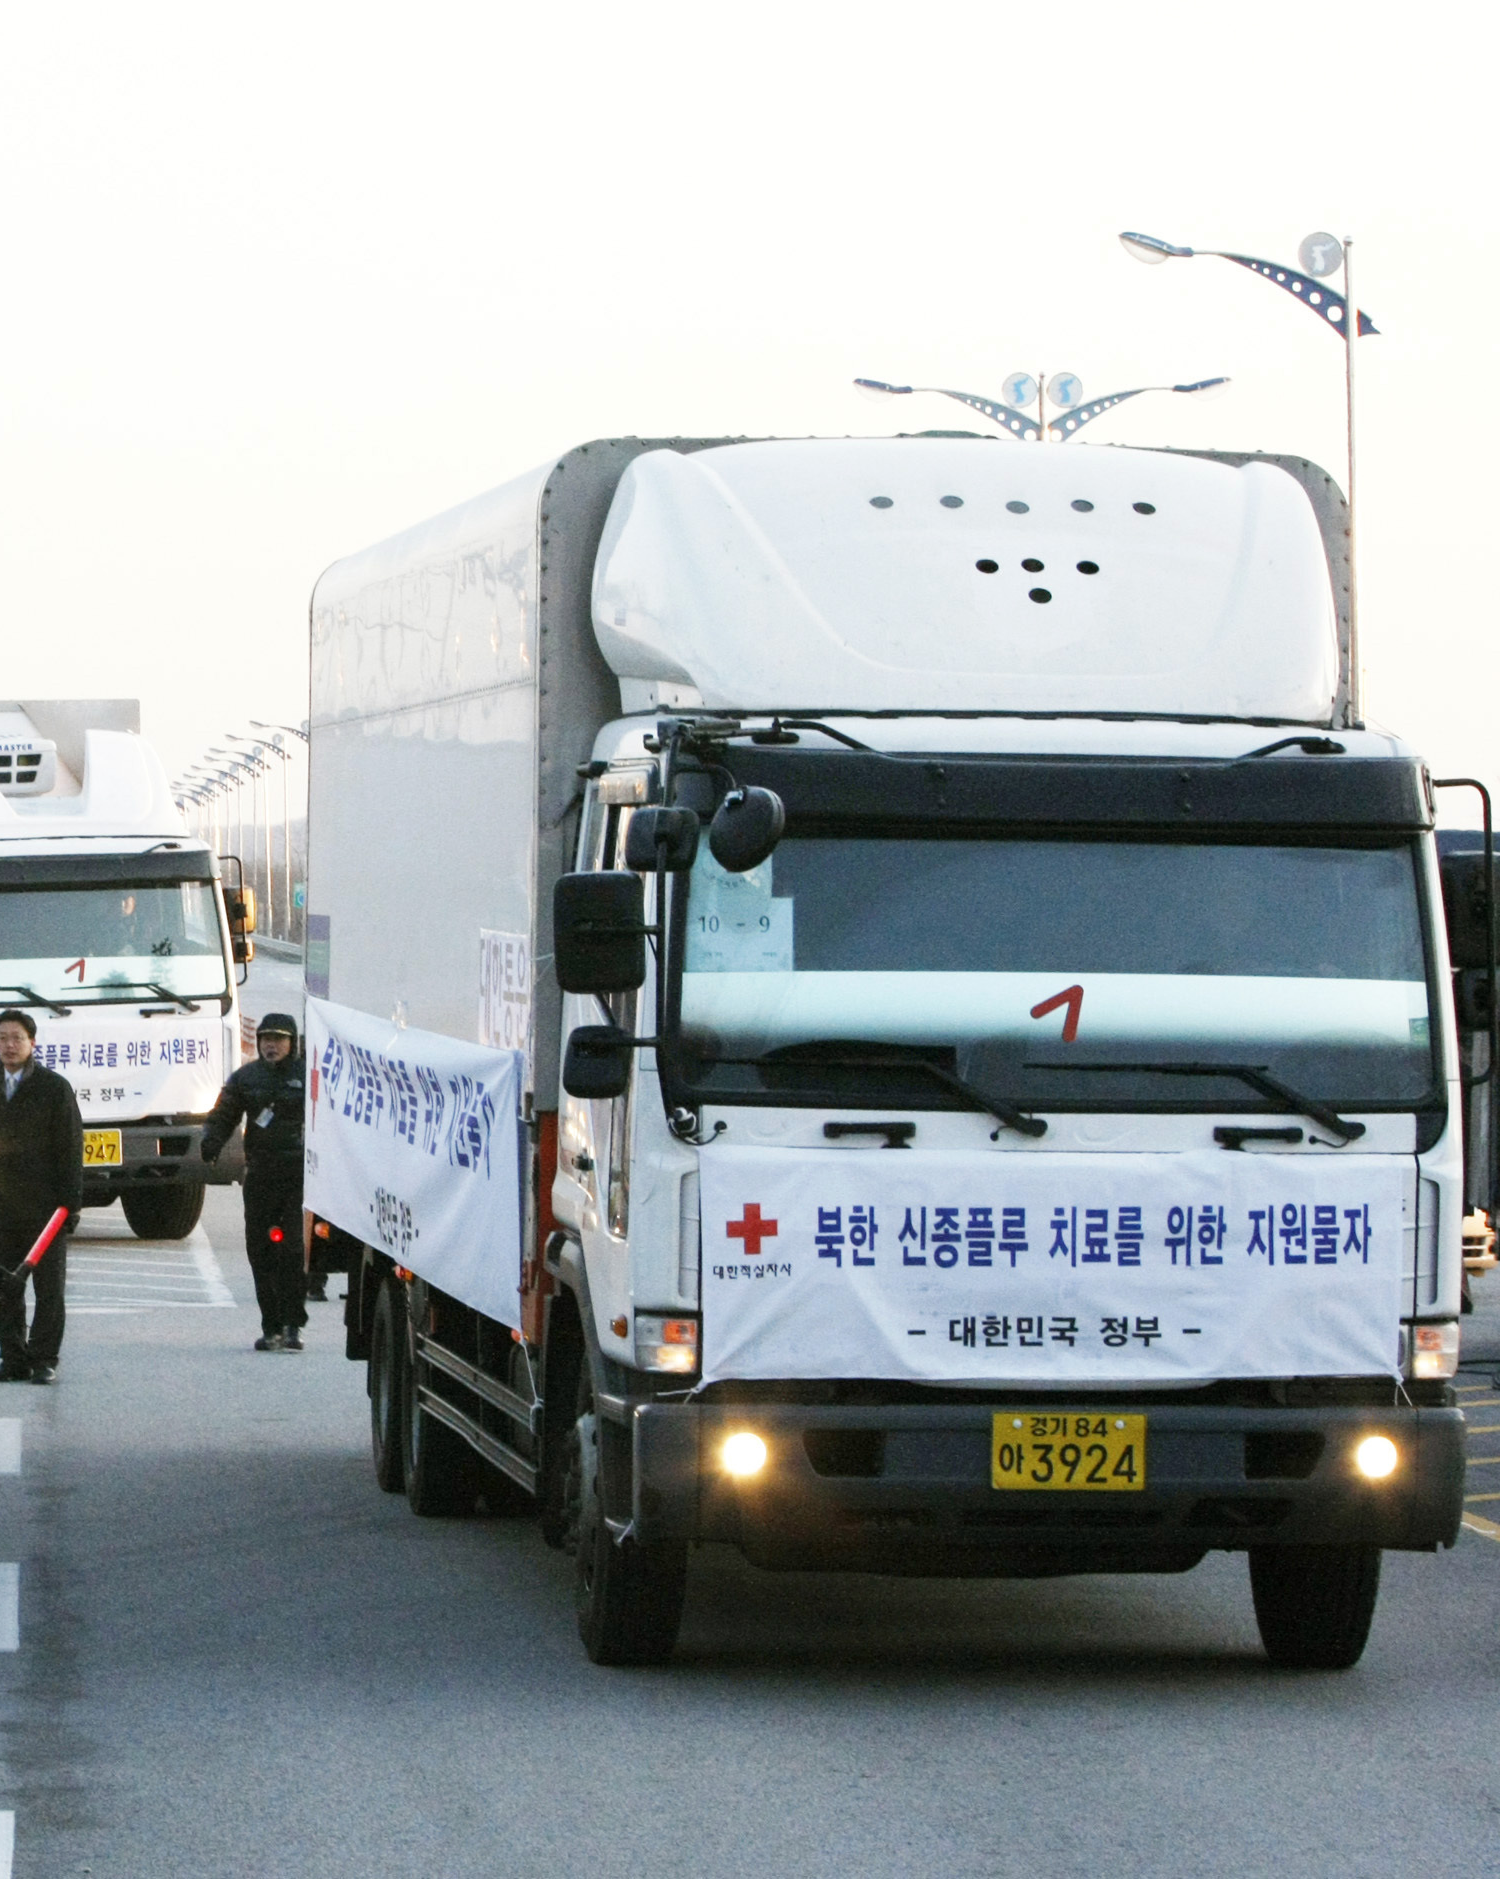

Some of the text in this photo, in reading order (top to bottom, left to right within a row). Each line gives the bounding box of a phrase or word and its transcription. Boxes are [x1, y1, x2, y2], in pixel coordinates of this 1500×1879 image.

[698, 915, 719, 933] 10
[759, 915, 770, 933] 9
[80, 1043, 117, 1068] 치료를
[127, 1041, 151, 1067] 위한
[160, 1038, 209, 1065] 지원물자
[100, 1088, 125, 1101] 정부
[85, 1144, 116, 1161] 947
[815, 1203, 1372, 1268] 북한 신종플루 치료를 위한 지원물자
[713, 1263, 791, 1279] 대한적십자사
[949, 1316, 1078, 1347] 대한민국
[1100, 1317, 1162, 1347] 정부
[1030, 1417, 1108, 1437] 경기 84
